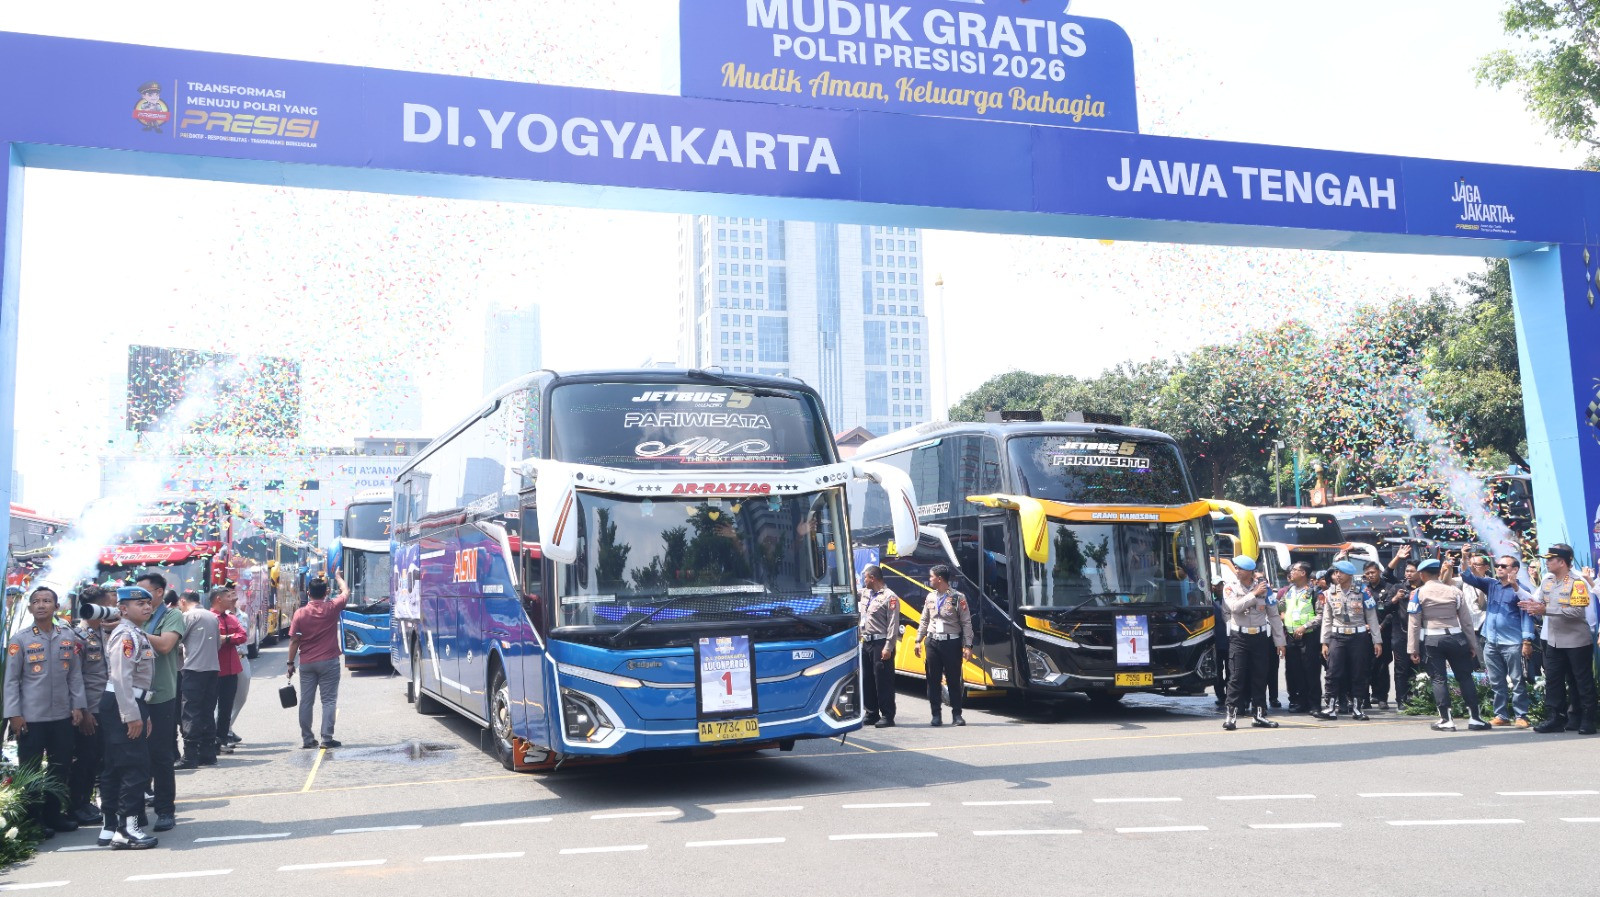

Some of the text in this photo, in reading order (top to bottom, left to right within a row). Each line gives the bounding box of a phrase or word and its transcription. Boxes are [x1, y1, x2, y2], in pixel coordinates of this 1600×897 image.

[746, 0, 1087, 57] MUDIK GRATIS
[773, 34, 1066, 82] POLRI PRESISI 2026
[187, 81, 286, 99] TRANSFORMASI
[721, 61, 1106, 123] Mudik Aman, Keluarga Bahagia
[186, 96, 318, 116] MENUJU POLRI YANG
[180, 109, 320, 139] PRESISI
[403, 102, 842, 175] DI.YOGYAKARTA
[1106, 157, 1397, 210] JAWA TENGAH
[1451, 181, 1482, 203] JAGA
[632, 391, 756, 408] JETBUS 5
[624, 412, 772, 429] PARIWISATA
[1058, 442, 1137, 455] JETBUS 5
[1053, 455, 1150, 468] PARIWISATA
[671, 483, 772, 495] AR-RAZZAQ
[1129, 638, 1137, 654] 1
[721, 671, 733, 695] 1
[701, 723, 713, 735] AA
[716, 721, 740, 734] 7734
